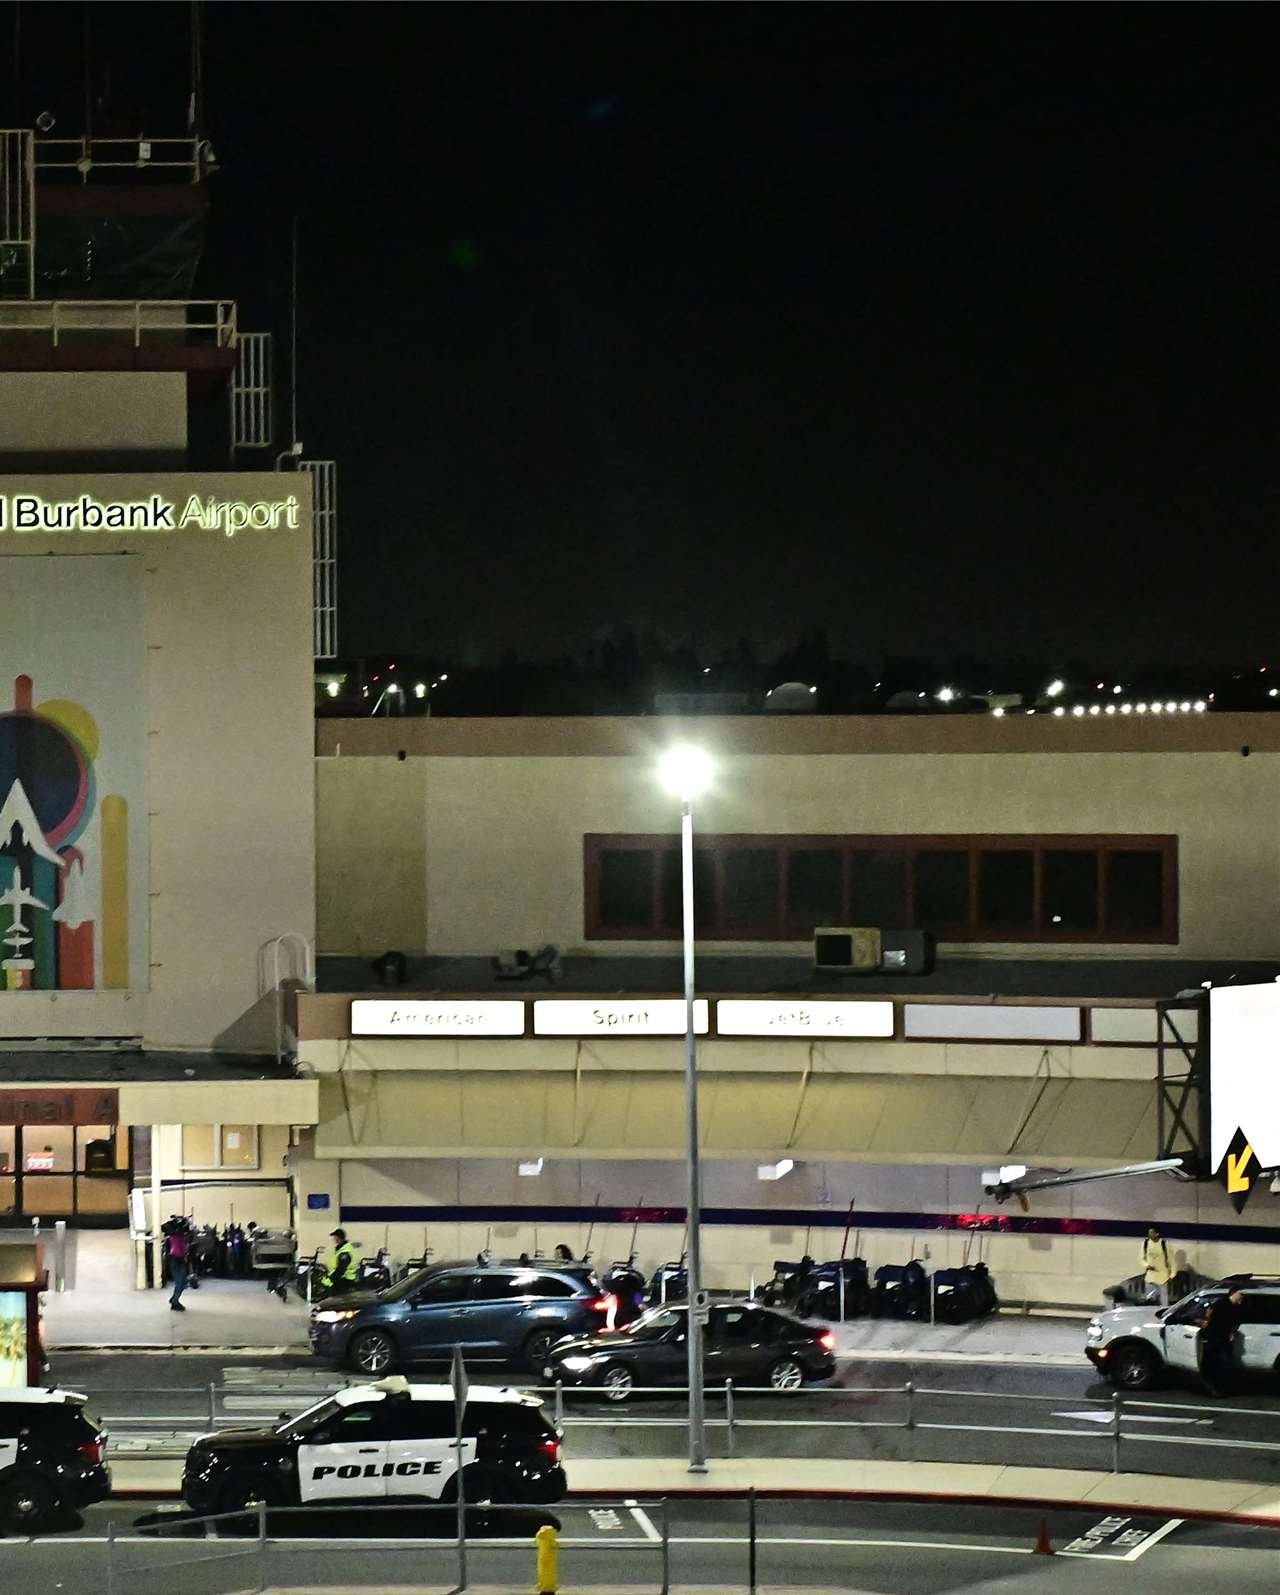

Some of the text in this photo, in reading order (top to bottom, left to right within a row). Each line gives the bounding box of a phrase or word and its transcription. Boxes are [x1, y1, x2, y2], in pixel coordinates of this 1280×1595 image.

[15, 497, 174, 529] Burbank
[180, 494, 299, 536] Airport
[389, 1010, 488, 1025] American
[592, 1009, 650, 1027] Spirit
[95, 1093, 117, 1121] A
[311, 1460, 443, 1481] POLICE
